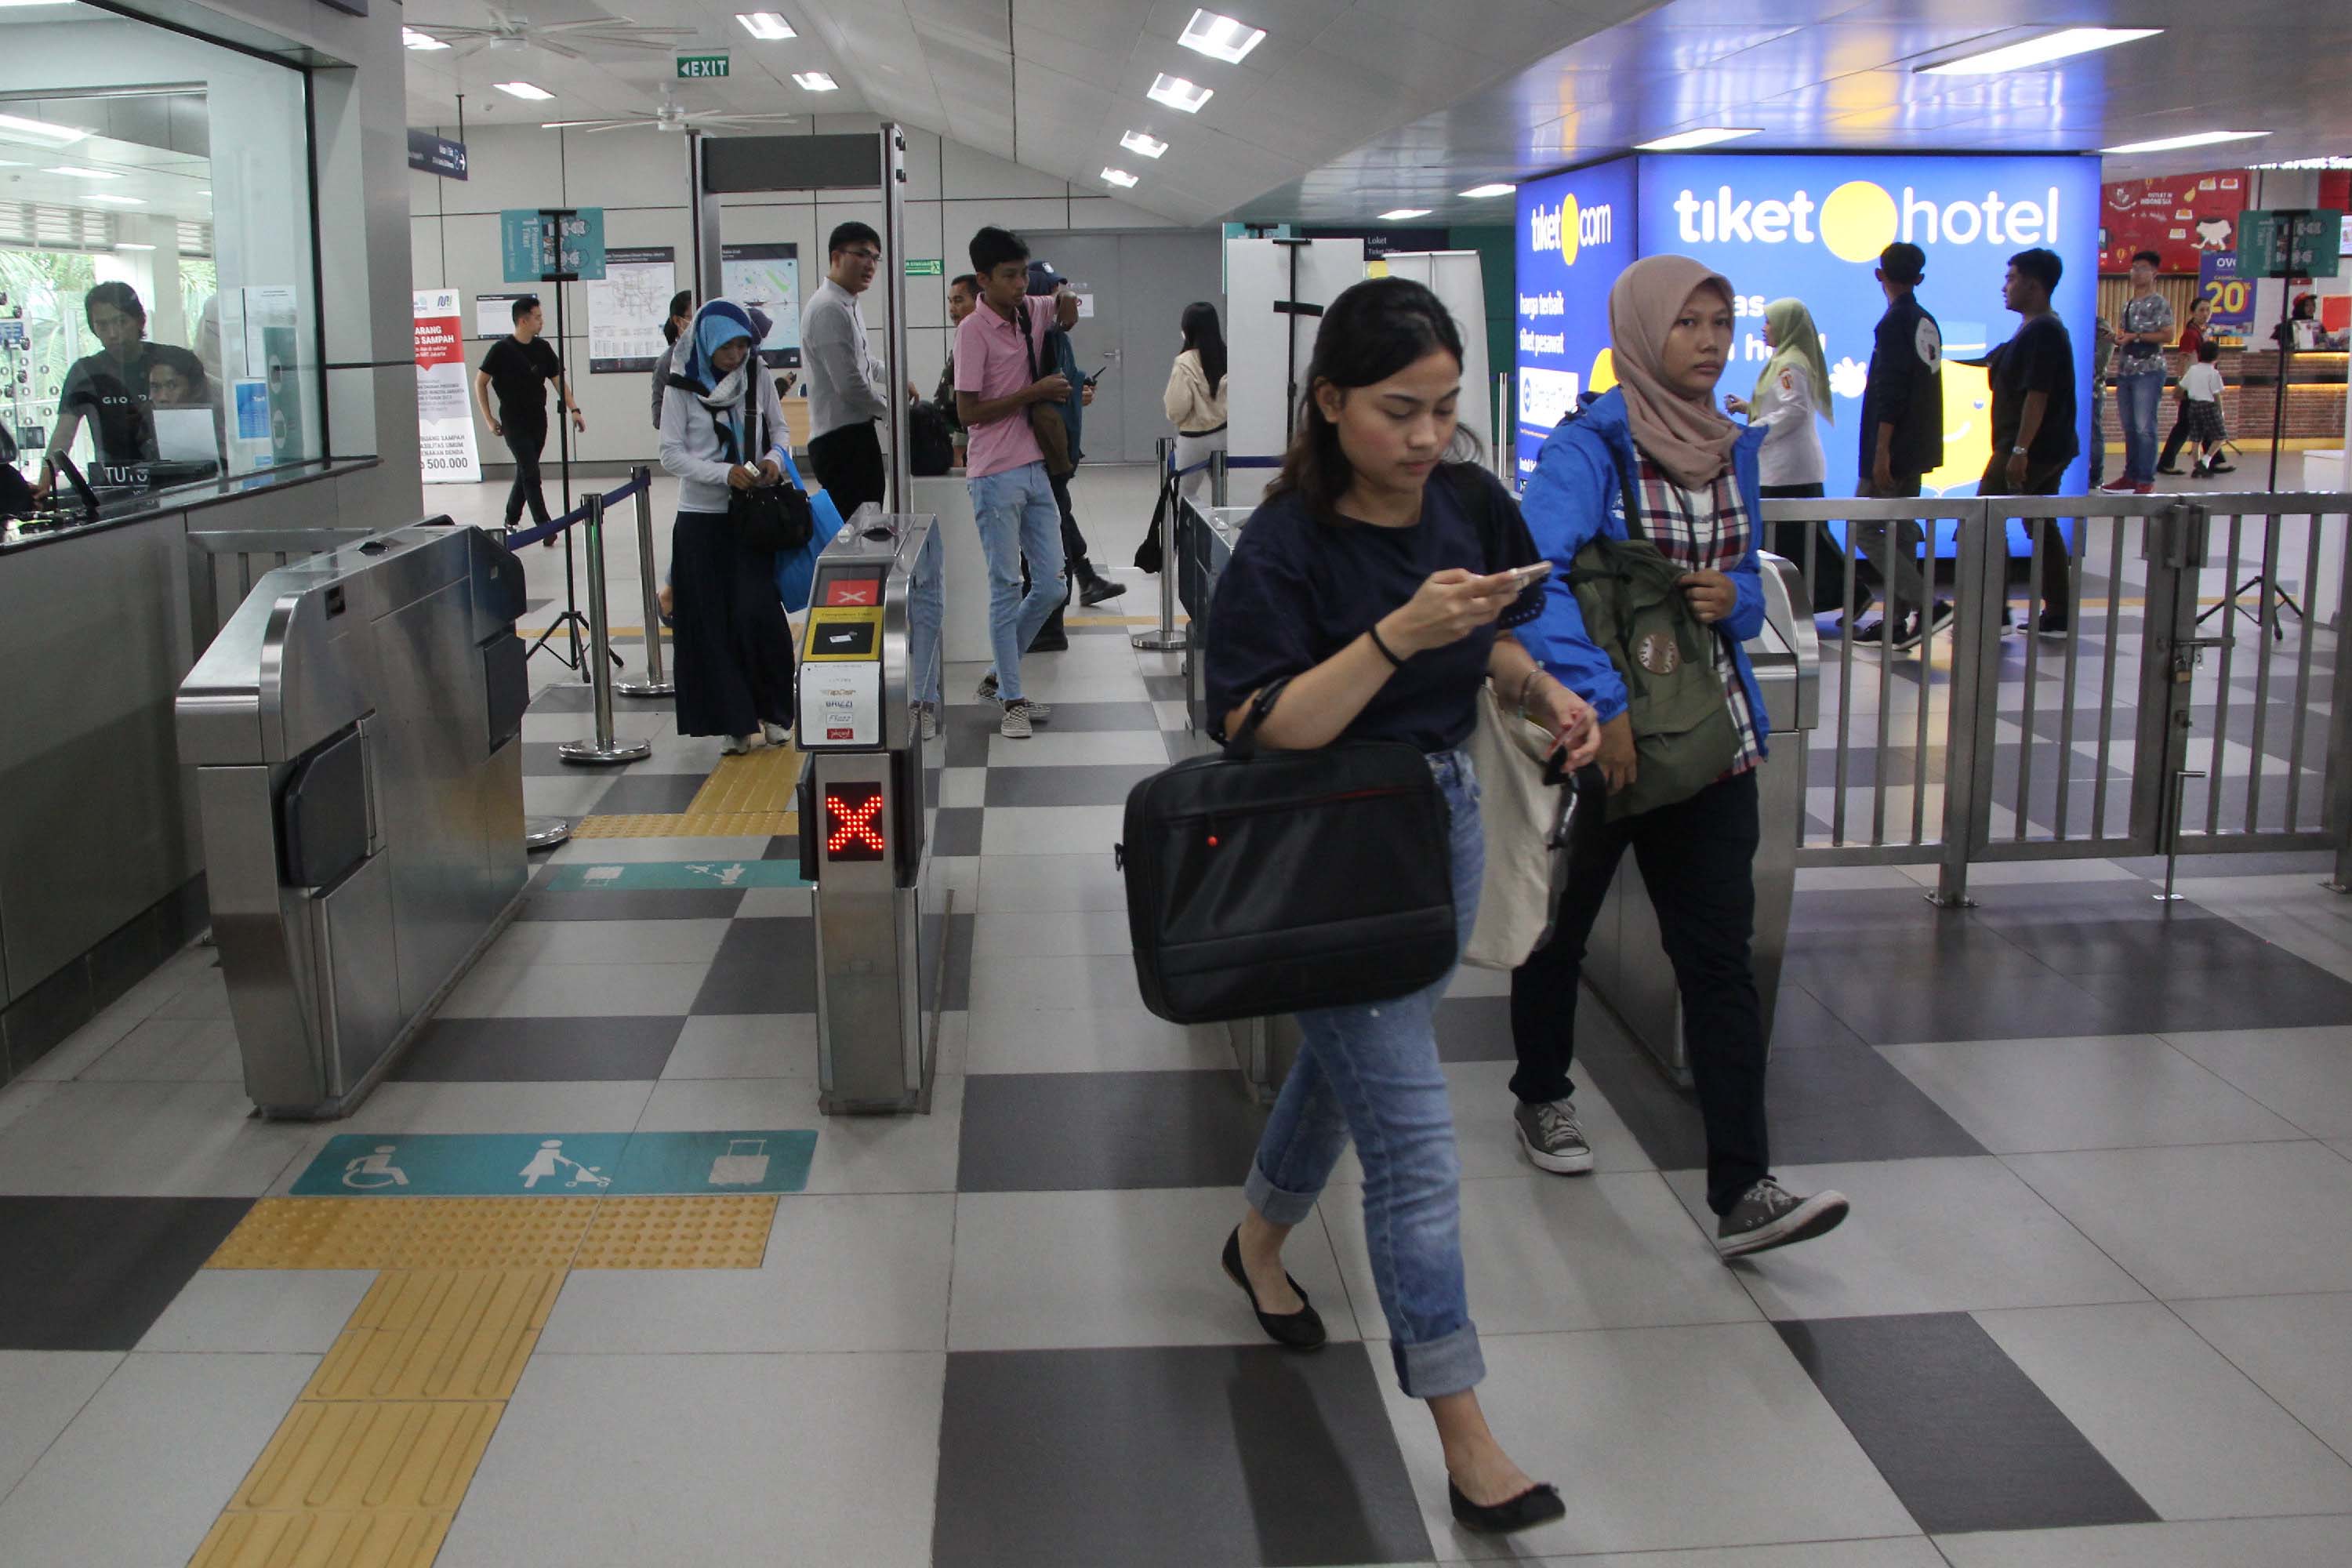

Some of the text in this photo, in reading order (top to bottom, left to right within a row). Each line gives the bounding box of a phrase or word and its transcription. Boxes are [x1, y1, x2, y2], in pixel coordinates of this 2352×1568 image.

[691, 60, 726, 76] EXIT
[1674, 186, 2059, 244] tiket hotel
[421, 335, 455, 344] SAMPAH
[427, 458, 468, 469] 500.000
